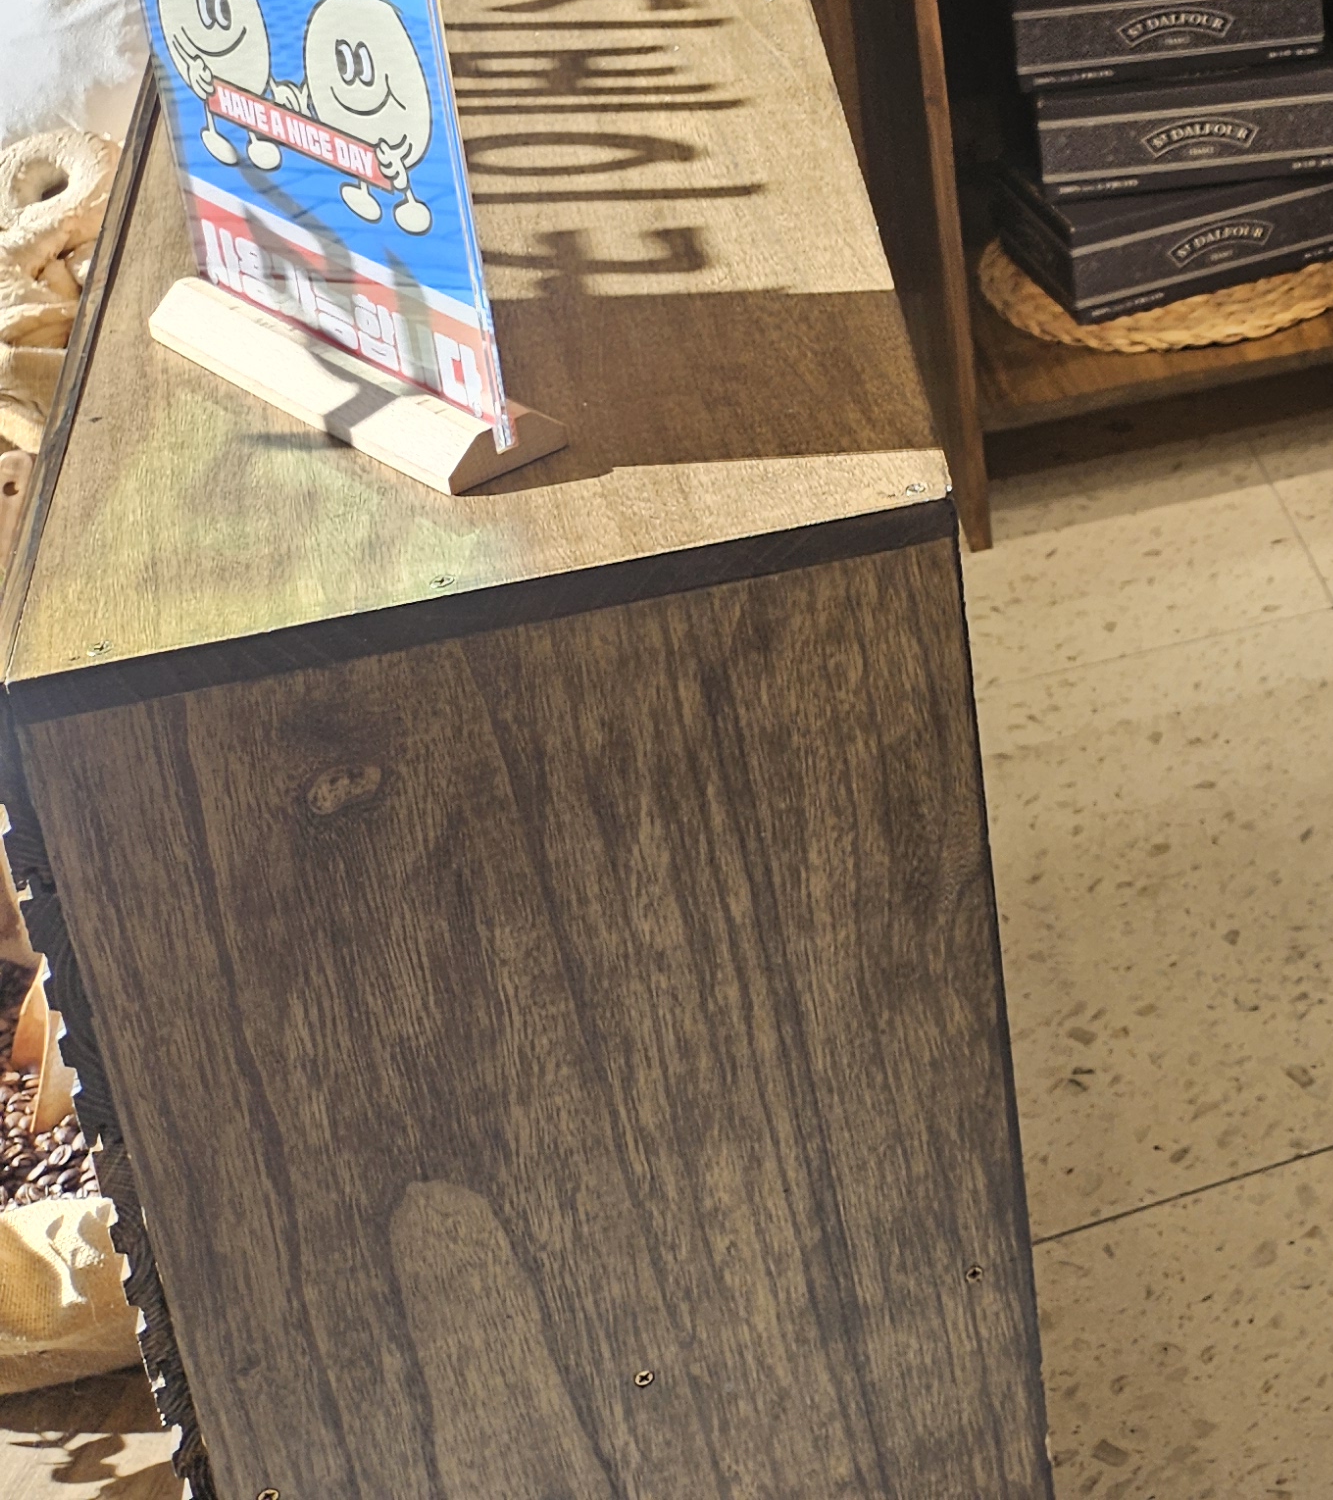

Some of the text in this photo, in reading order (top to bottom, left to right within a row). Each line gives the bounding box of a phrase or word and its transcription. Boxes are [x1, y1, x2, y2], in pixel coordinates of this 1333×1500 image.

[216, 86, 376, 178] HAVE A NICE DAY
